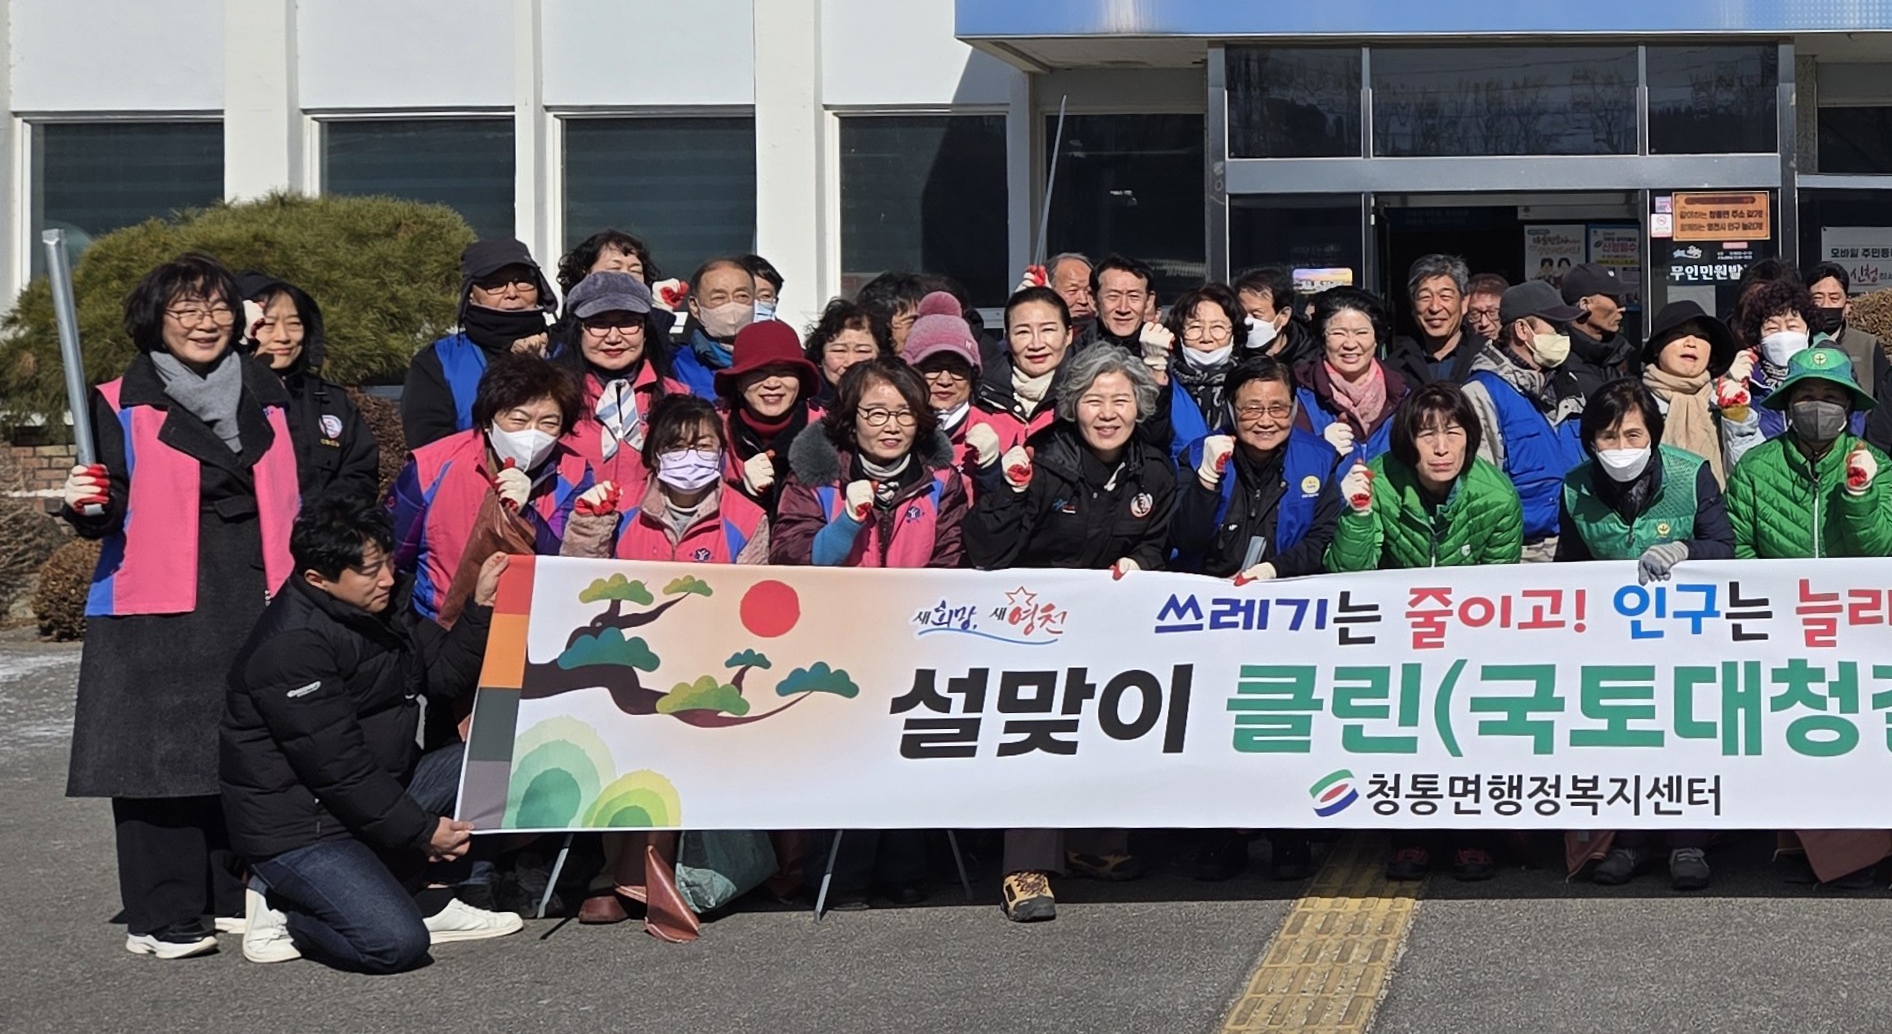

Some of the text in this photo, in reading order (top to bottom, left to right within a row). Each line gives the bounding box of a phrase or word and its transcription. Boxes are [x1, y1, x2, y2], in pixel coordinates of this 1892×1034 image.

[1831, 247, 1859, 258] 모바일
[1670, 264, 1748, 281] 무인민원발
[912, 610, 931, 625] 새
[989, 606, 1007, 621] 새
[1008, 603, 1068, 636] 영천
[1154, 590, 1382, 646] 쓰레기는
[1404, 586, 1587, 651] 줄이고!
[1612, 580, 1773, 642] 인구는
[889, 663, 1195, 761] 설맞이
[1366, 772, 1723, 818] 청통면행정복지센터
